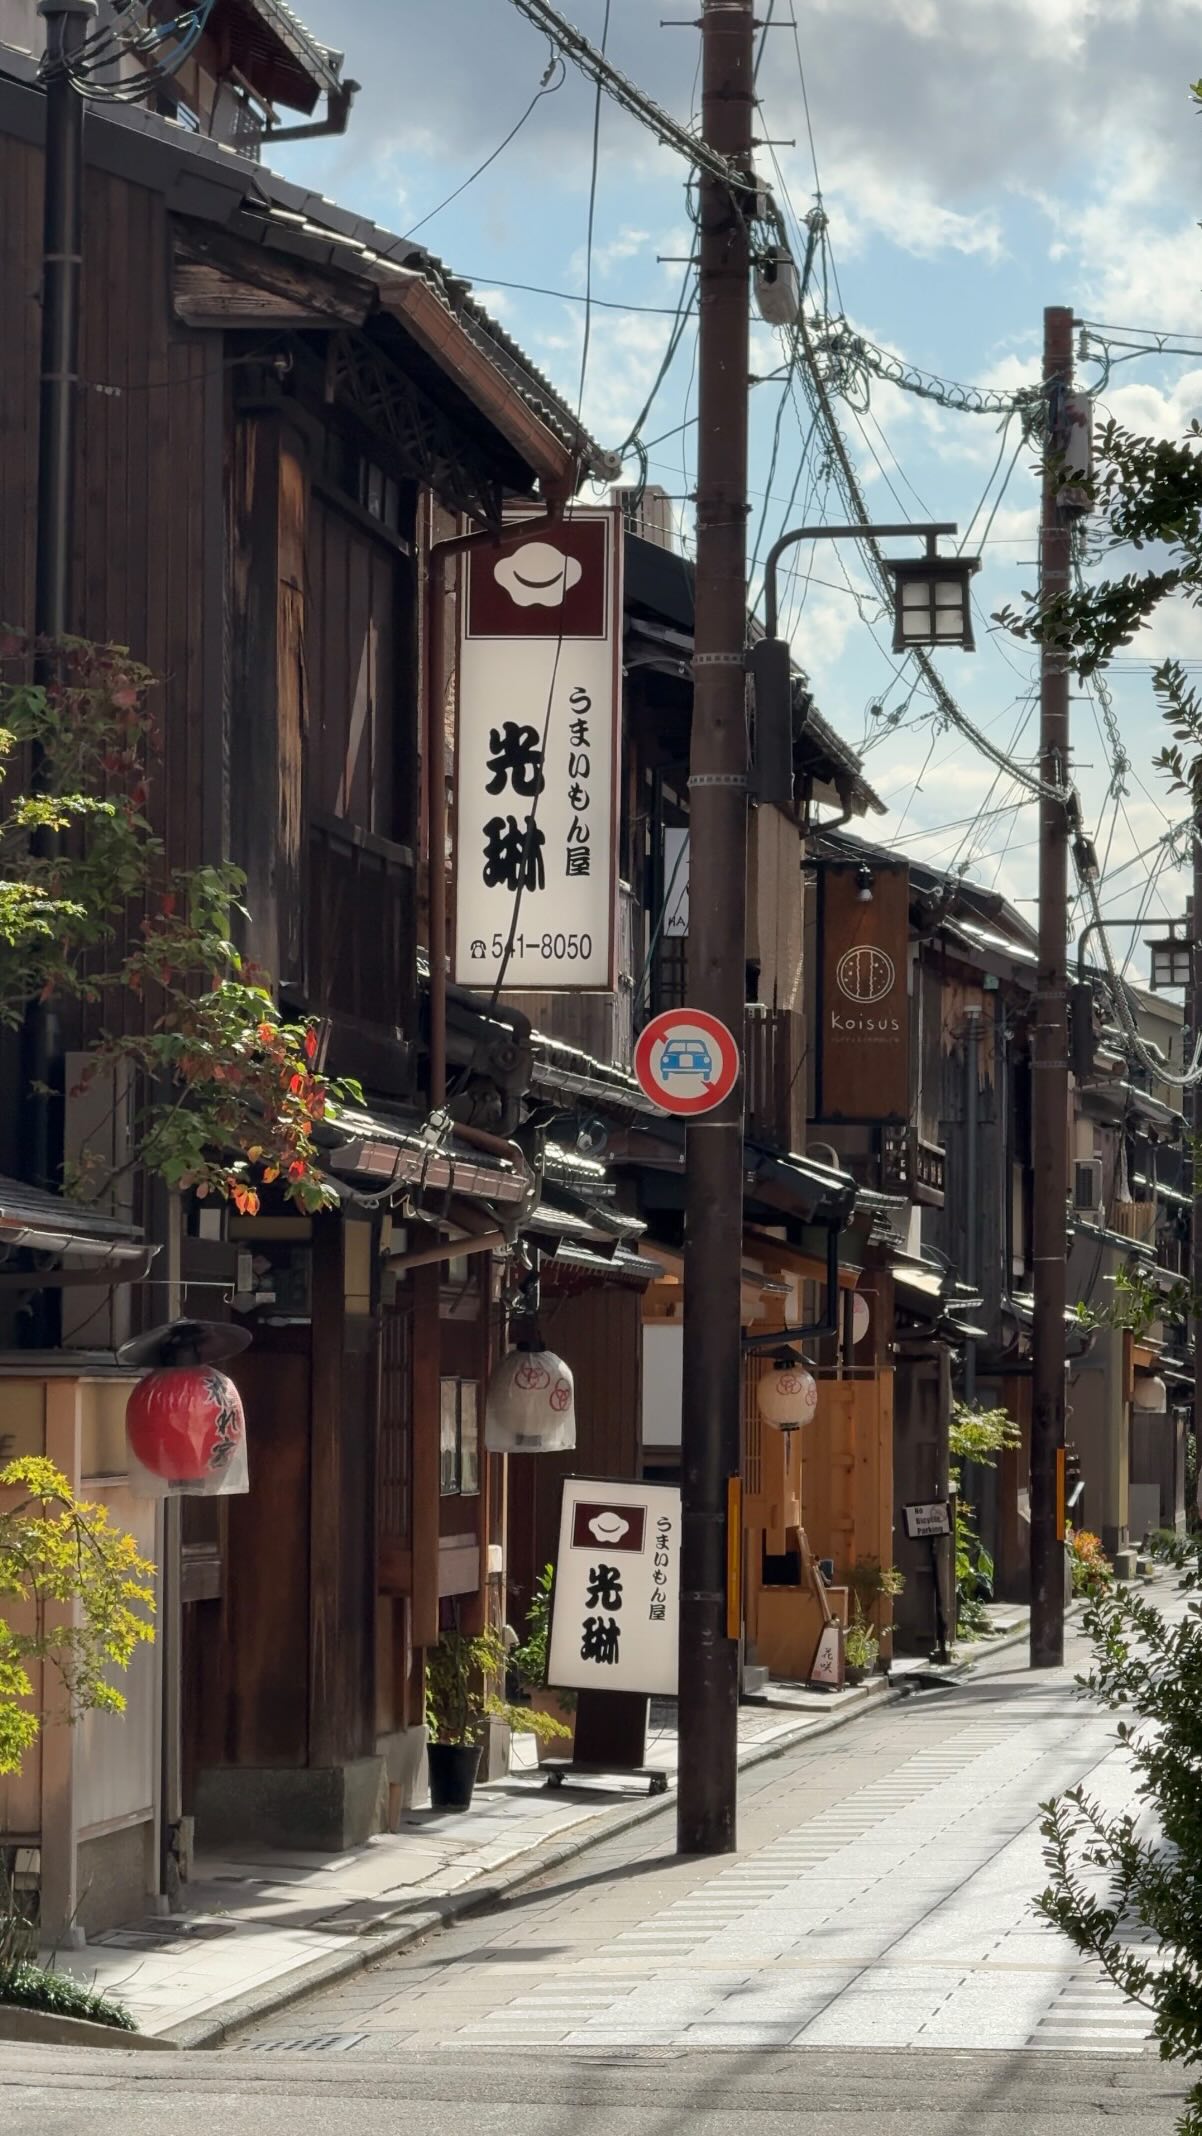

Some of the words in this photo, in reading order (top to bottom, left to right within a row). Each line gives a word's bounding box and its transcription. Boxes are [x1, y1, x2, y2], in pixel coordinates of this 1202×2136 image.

[482, 721, 546, 893] 光琳
[565, 686, 592, 877] うまいもん屋
[491, 933, 593, 960] 541-8050
[580, 1563, 623, 1665] 光琳
[648, 1516, 672, 1621] うまいもん屋
